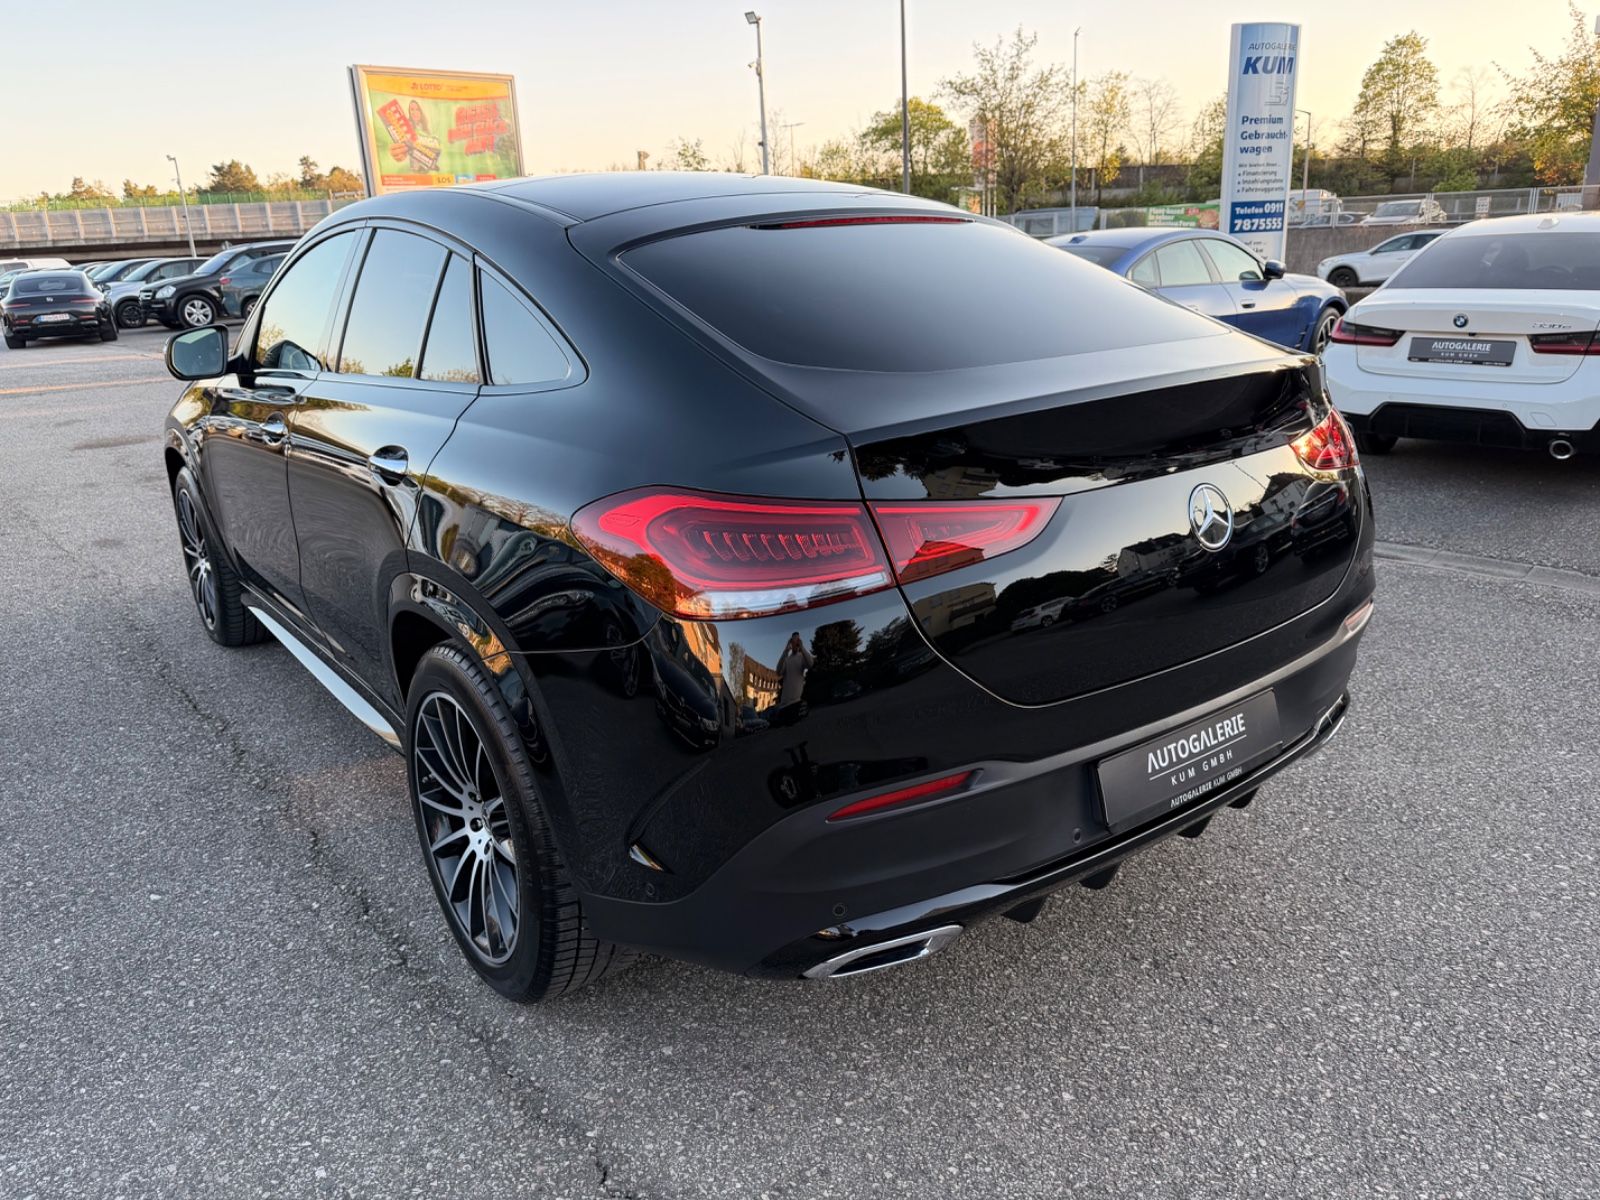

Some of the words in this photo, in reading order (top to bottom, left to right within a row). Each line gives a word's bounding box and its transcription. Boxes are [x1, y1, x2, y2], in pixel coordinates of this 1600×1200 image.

[1242, 55, 1295, 75] KUM
[1241, 115, 1284, 125] Premium
[1239, 145, 1273, 156] wagen
[1235, 206, 1264, 215] Telefon
[1264, 202, 1284, 214] 0911
[1234, 217, 1283, 232] 7875555
[1432, 341, 1492, 351] AUTOGALERIE
[1147, 713, 1246, 773] AUTOGALERIE
[1170, 766, 1197, 787] KUM
[1202, 749, 1233, 771] GMBH
[1170, 781, 1212, 808] AUTOGALERIE
[1213, 774, 1226, 787] KUM
